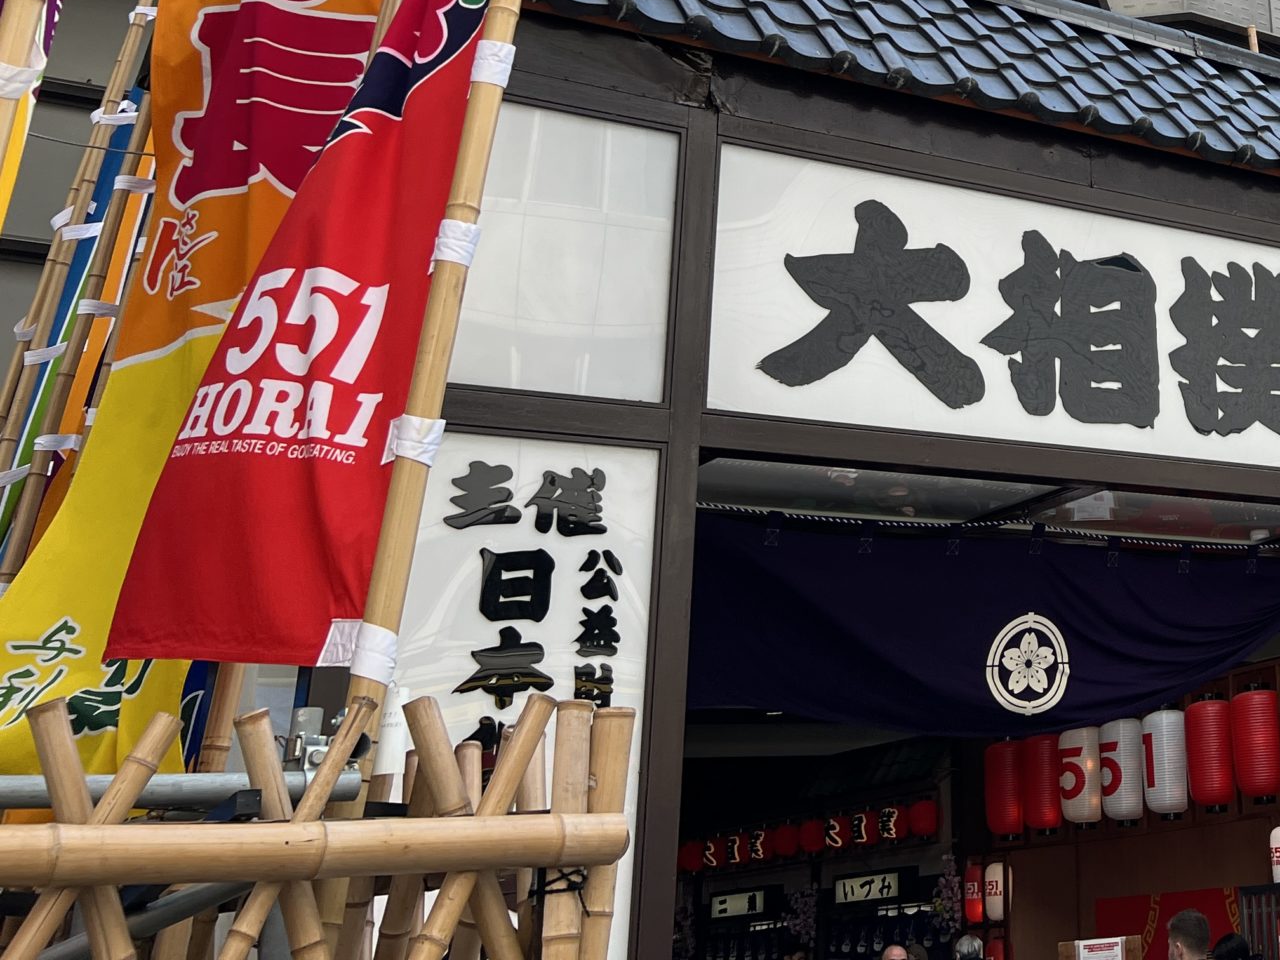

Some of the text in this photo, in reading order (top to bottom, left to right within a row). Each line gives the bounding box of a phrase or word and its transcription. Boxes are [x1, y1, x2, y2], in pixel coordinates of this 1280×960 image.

[226, 267, 391, 384] 551
[178, 378, 384, 448] HORAI
[192, 442, 208, 454] THE
[209, 440, 230, 453] REAL
[231, 439, 262, 453] TASTE
[266, 442, 285, 456] OF
[443, 461, 608, 537] 主催
[451, 547, 555, 752] 日本
[1058, 732, 1156, 800] 551
[842, 876, 892, 900] いづみ
